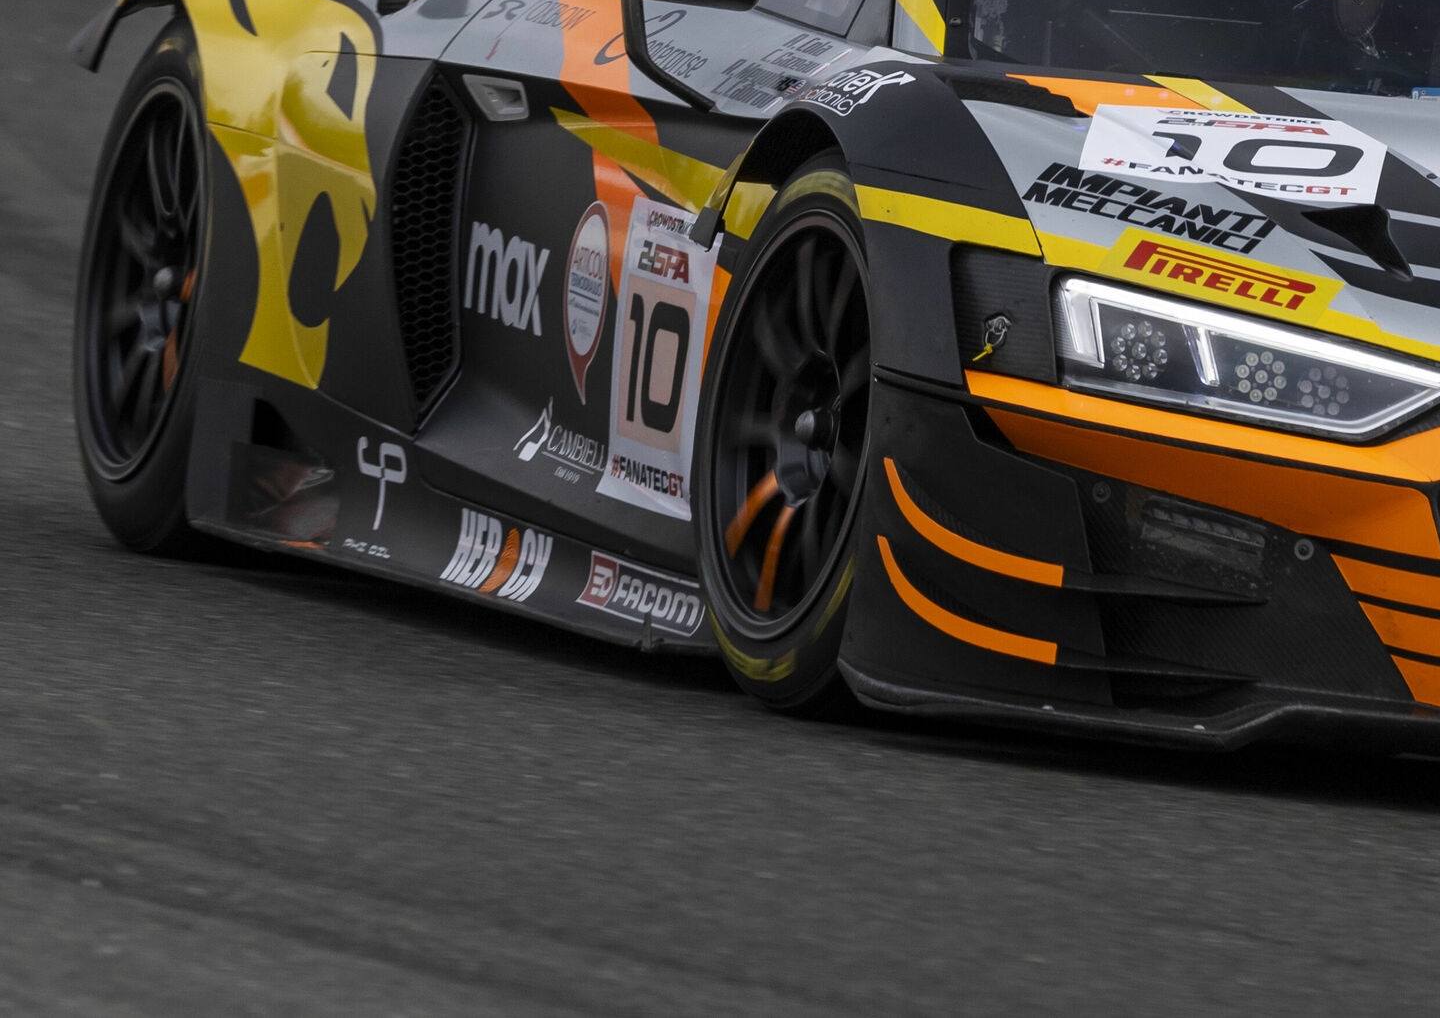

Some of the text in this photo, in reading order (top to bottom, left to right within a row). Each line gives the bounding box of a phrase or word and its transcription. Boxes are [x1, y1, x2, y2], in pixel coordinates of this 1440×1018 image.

[1168, 109, 1323, 126] CROWDSTRIKE
[1152, 130, 1365, 178] 10
[1021, 182, 1262, 254] MECCANICI
[1037, 162, 1278, 238] IMPIANTI
[464, 221, 551, 336] max
[1123, 240, 1316, 311] PIRELLI
[626, 292, 691, 434] 10
[611, 454, 685, 499] #FANATECGT
[612, 574, 700, 627] FACOM
